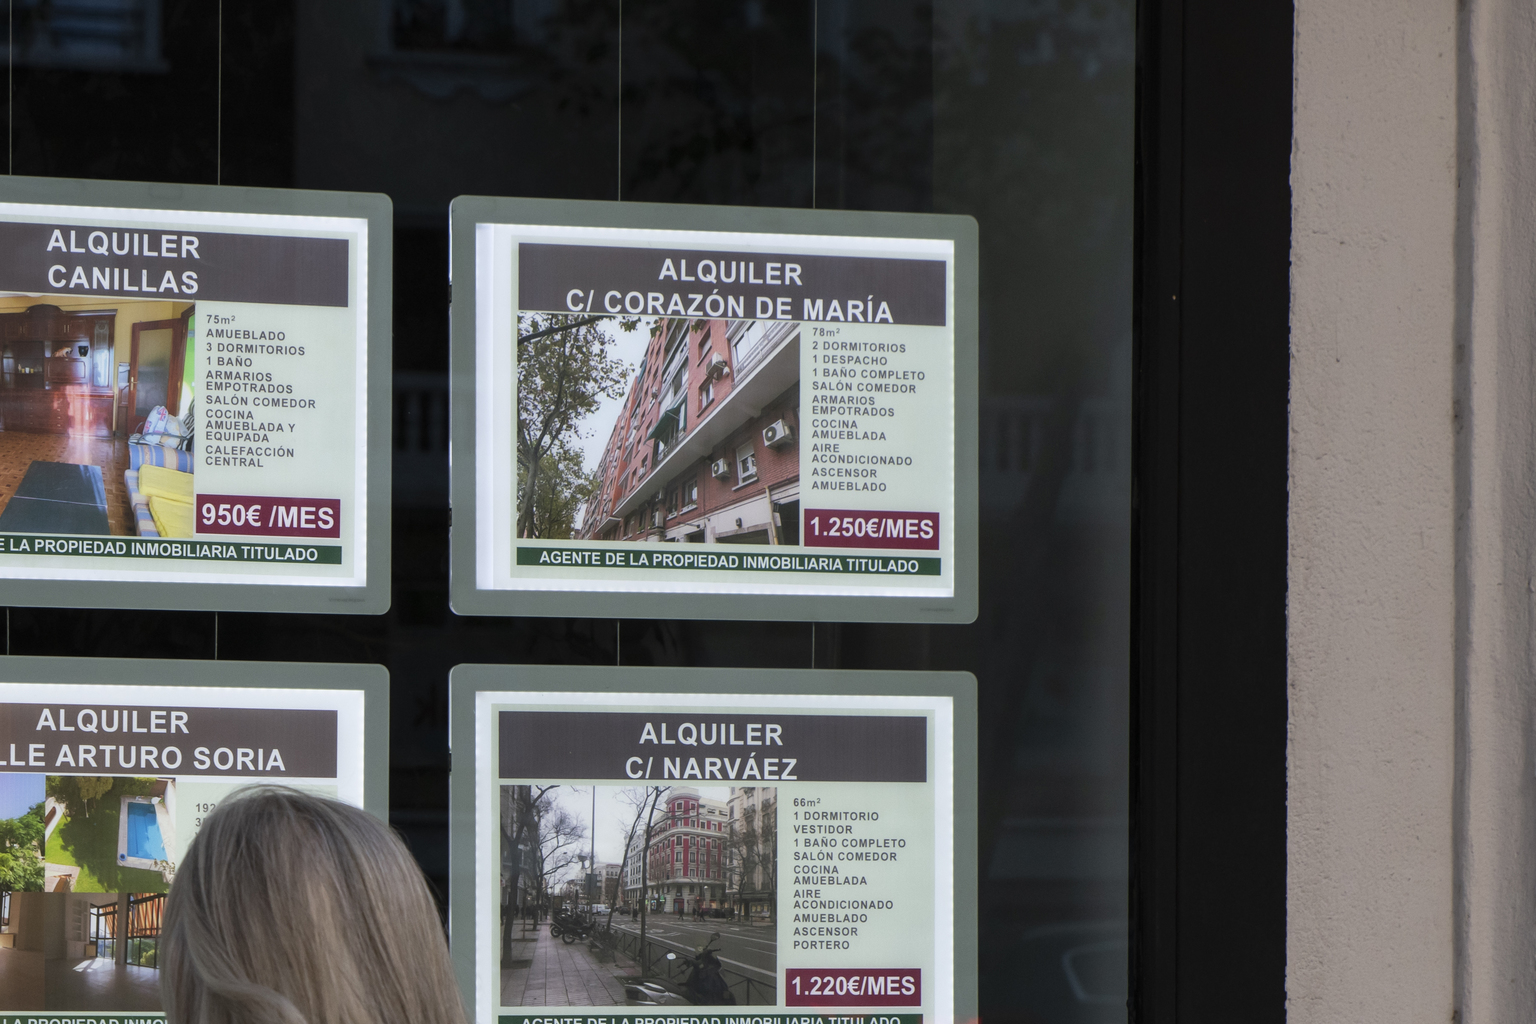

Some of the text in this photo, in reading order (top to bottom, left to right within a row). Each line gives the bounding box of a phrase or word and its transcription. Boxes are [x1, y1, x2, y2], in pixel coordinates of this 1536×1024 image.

[46, 229, 200, 259] ALQUILER
[658, 258, 802, 285] ALQUILER
[48, 265, 198, 294] CANILLAS
[566, 289, 894, 323] C/ CORAZÓN DE MARÍA
[206, 328, 285, 341] AMUEBLADO
[206, 370, 272, 382] ARMARIOS
[206, 381, 293, 394] EMPOTRADOS
[812, 380, 916, 393] SALÓN COMEDOR
[206, 394, 316, 409] SALÓN COMEDOR
[812, 395, 875, 406] ARMARIOS
[206, 409, 254, 420] COCINA
[812, 405, 894, 417] EMPOTRADOS
[206, 420, 295, 432] AMUEBLADA Y
[812, 419, 858, 429] COCINA
[206, 431, 269, 443] EQUIPADA
[812, 430, 886, 441] AMUEBLADA
[205, 445, 294, 458] CALEFACCIÓN
[812, 443, 840, 453] AIRE
[812, 454, 912, 466] ACONDICIONADO
[812, 467, 877, 478] ASCENSOR
[812, 481, 886, 492] AMUEBLADO
[811, 517, 934, 539] 1.250€/MES
[540, 551, 919, 572] AGENTE DE LA PROPIEDAD INMOBILIARIA TITULADO
[36, 708, 189, 734] ALQUILER
[639, 722, 783, 746] ALQUILER
[55, 744, 182, 769] ARTURO
[193, 747, 286, 771] SORIA
[626, 752, 797, 780] C/ NARVÁEZ
[793, 825, 852, 834] VESTIDOR
[794, 850, 897, 861] SALÓN COMEDOR
[793, 865, 839, 874] COCINA
[793, 876, 867, 885] AMUEBLADA
[793, 889, 821, 899] AIRE
[793, 900, 894, 910] ACONDICIONADO
[793, 913, 868, 923] AMUEBLADO
[793, 927, 858, 936] ASCENSOR
[794, 940, 850, 950] PORTERO
[792, 976, 915, 995] 1.220€/MES
